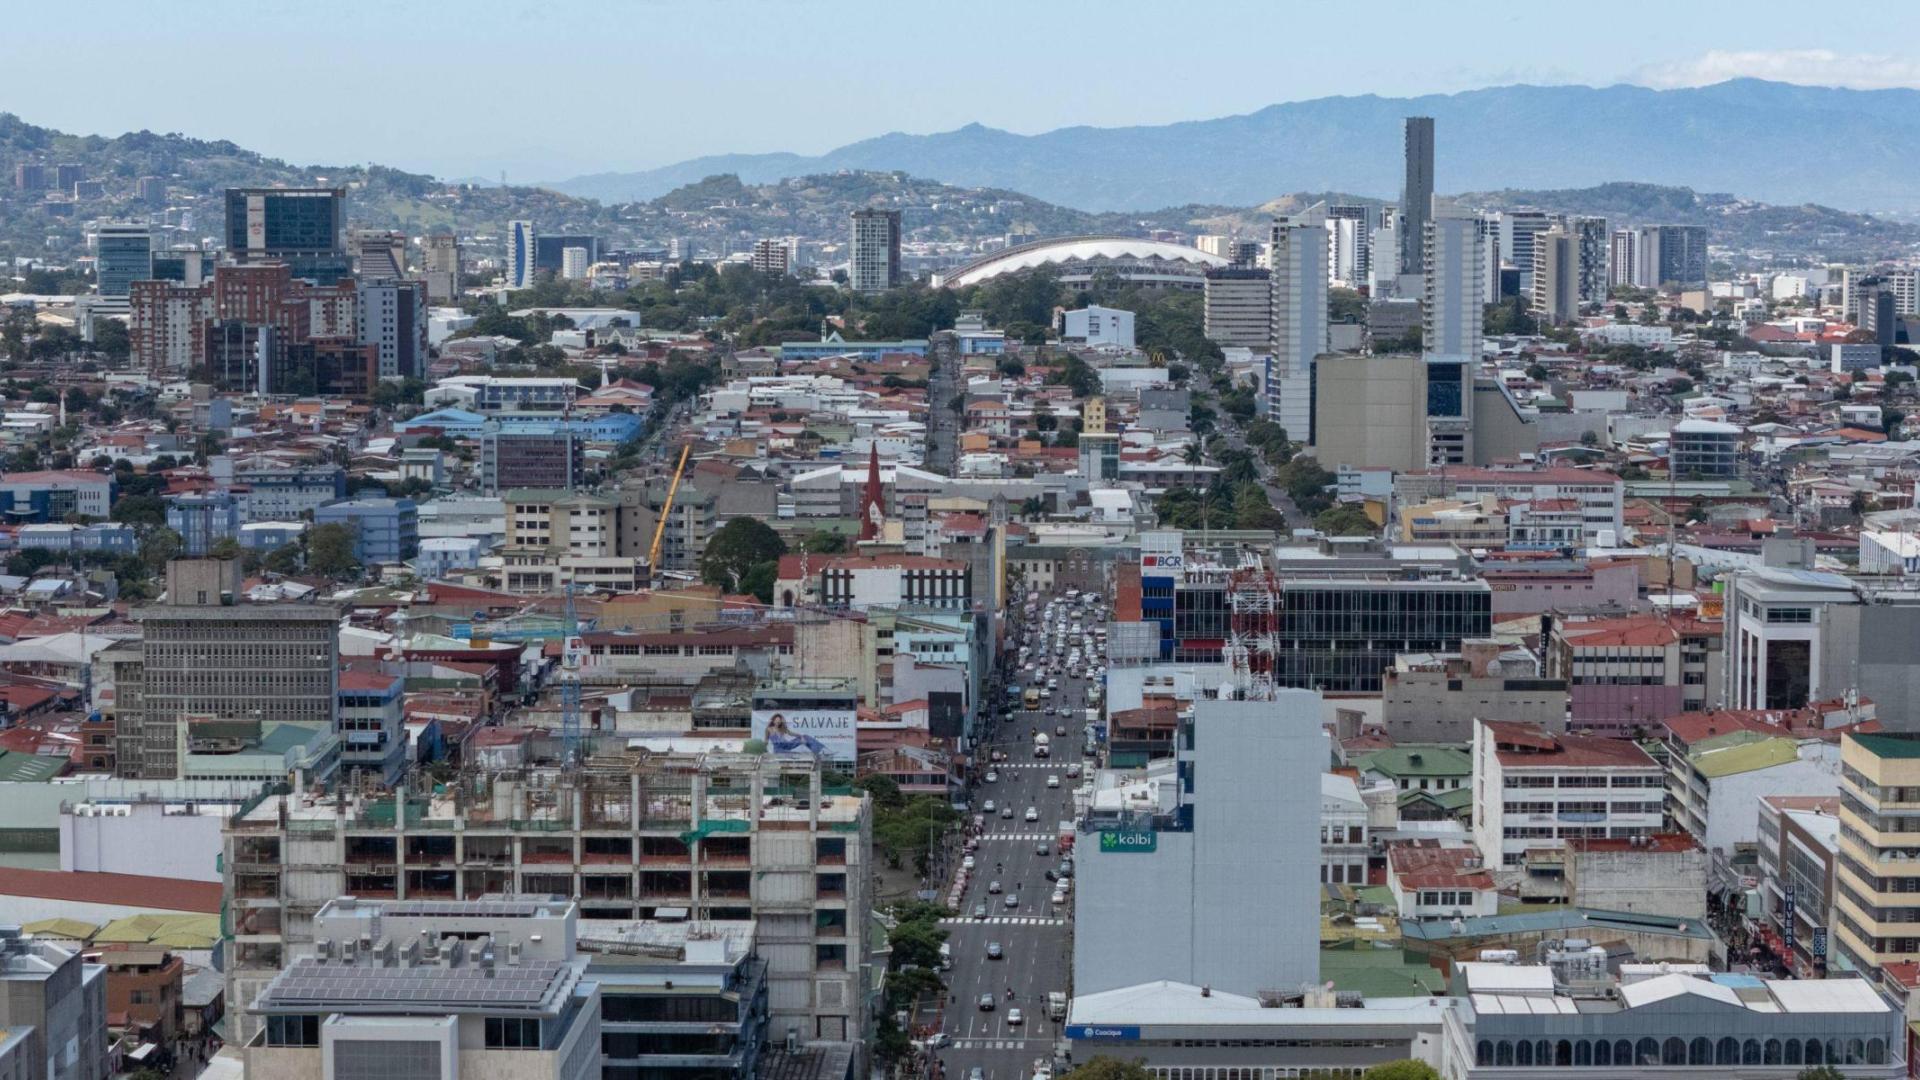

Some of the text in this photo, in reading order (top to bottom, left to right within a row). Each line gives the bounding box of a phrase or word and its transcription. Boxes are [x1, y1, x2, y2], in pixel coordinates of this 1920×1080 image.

[1158, 556, 1182, 566] BCR
[792, 716, 849, 728] SALVAJE
[1785, 886, 1793, 948] UNIVERS
